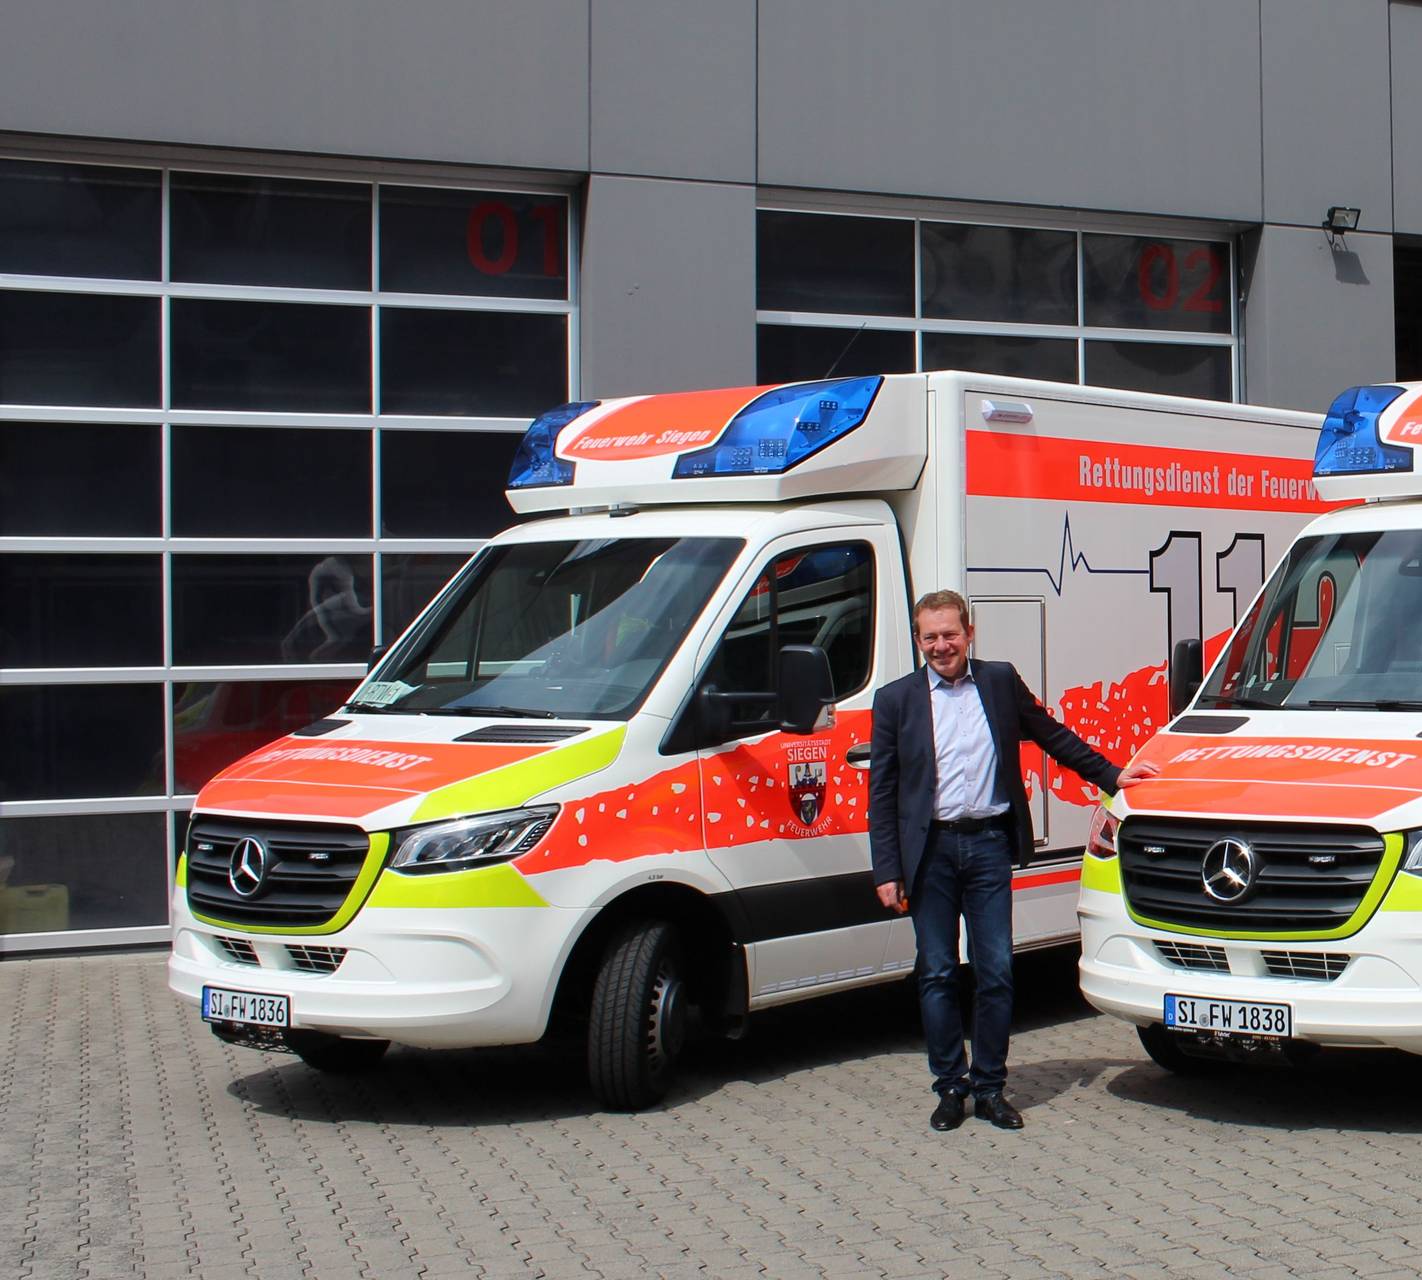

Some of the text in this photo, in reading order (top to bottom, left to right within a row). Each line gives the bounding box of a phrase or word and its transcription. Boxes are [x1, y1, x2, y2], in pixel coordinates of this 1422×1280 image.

[467, 200, 560, 277] 01
[1139, 243, 1223, 313] 02
[573, 429, 712, 450] Feuerwehr Siegen
[1079, 455, 1322, 501] Rettungsdienst der Feuerw
[250, 747, 434, 770] RETTUNGSDIENST
[787, 747, 827, 762] SIEGEN
[1168, 744, 1417, 769] RETTUNGSDIENST
[786, 816, 833, 837] FEUERWEHR
[211, 993, 223, 1015] SI
[231, 996, 246, 1018] FW
[250, 998, 285, 1023] 1836
[1178, 1001, 1286, 1033] SI FW 1838
